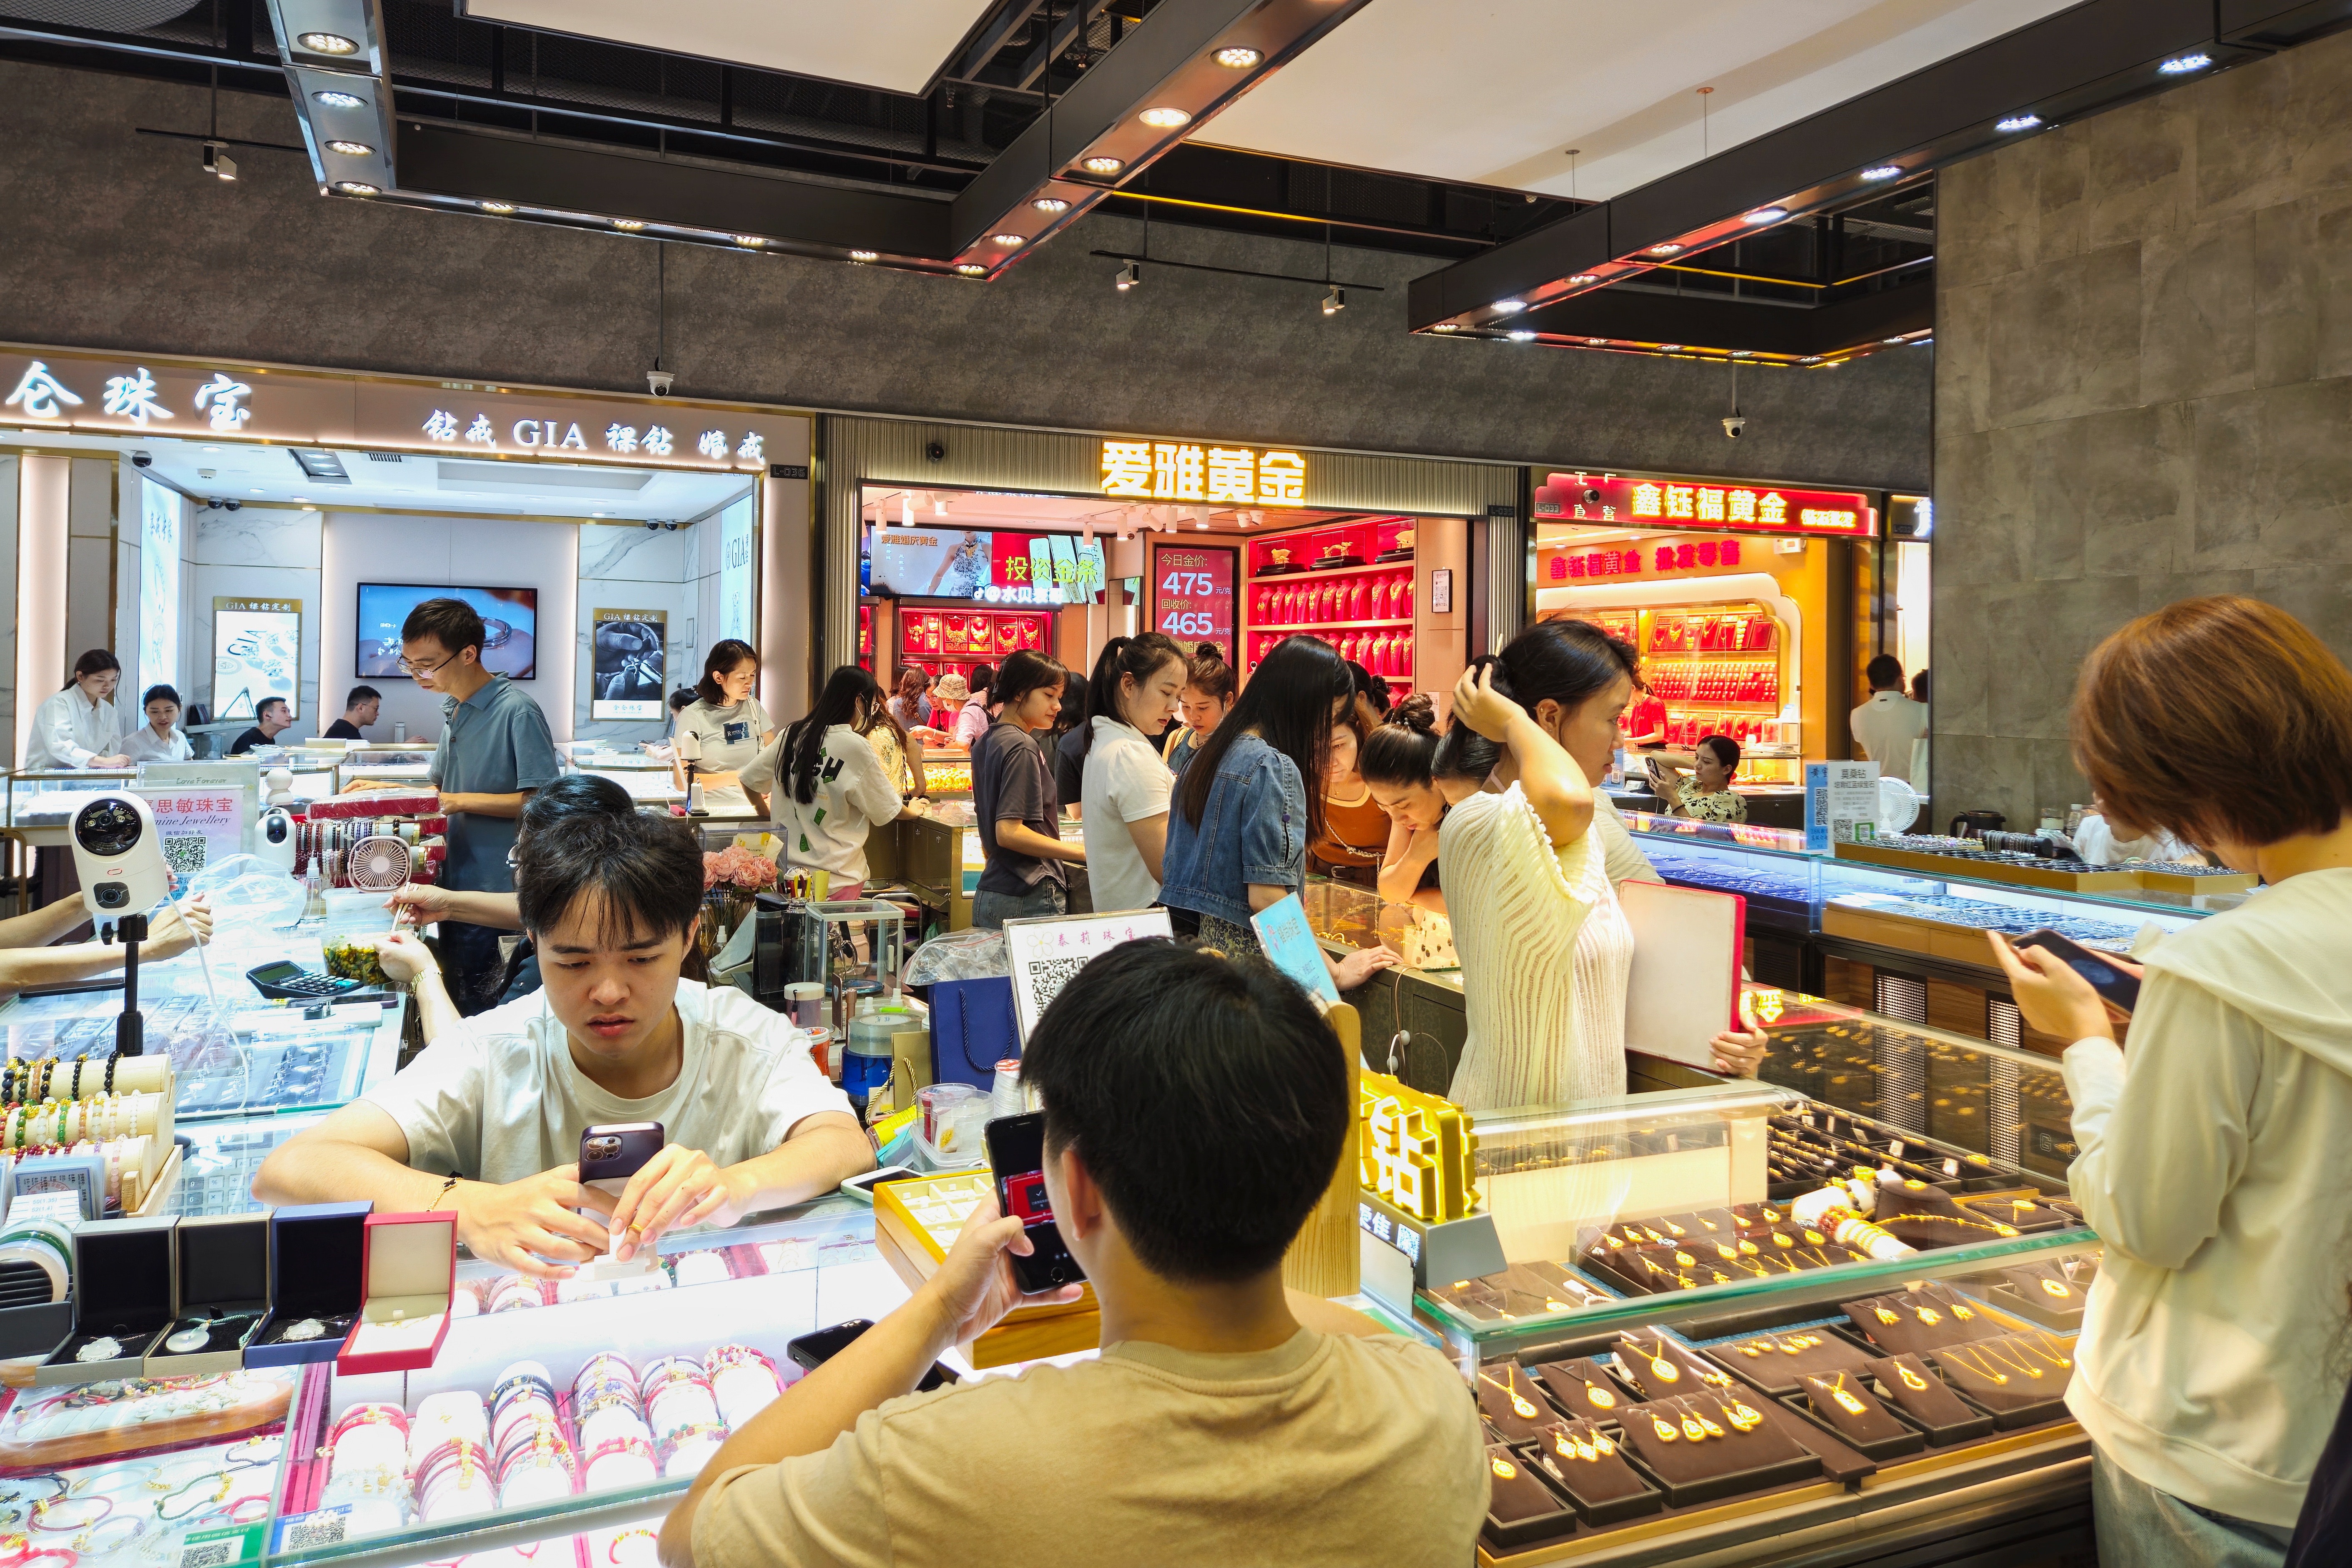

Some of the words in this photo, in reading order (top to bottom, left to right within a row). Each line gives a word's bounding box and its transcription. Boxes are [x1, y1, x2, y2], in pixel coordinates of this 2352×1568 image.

[6, 361, 251, 430] 仑珠宝
[513, 419, 588, 450] GIA
[774, 467, 805, 477] L-036
[1101, 442, 1305, 506] 爱雅黄金
[1574, 504, 1616, 521] 直营
[1632, 483, 1787, 524] 鑫钰福黄金
[732, 534, 745, 569] GIA
[882, 534, 937, 546] 爱雅婚庆黄金
[1005, 555, 1098, 583] 投资金条
[1161, 554, 1207, 567] 今日金价:
[1550, 549, 1641, 579] 鑫钰福黄金
[1656, 540, 1740, 571] 批发零售
[1162, 572, 1213, 595] 475
[1161, 599, 1191, 610] 回收价:
[623, 613, 658, 622] 裸钻定制
[1162, 612, 1213, 635] 465
[226, 630, 267, 655] GIA
[179, 815, 231, 825] Jewellery
